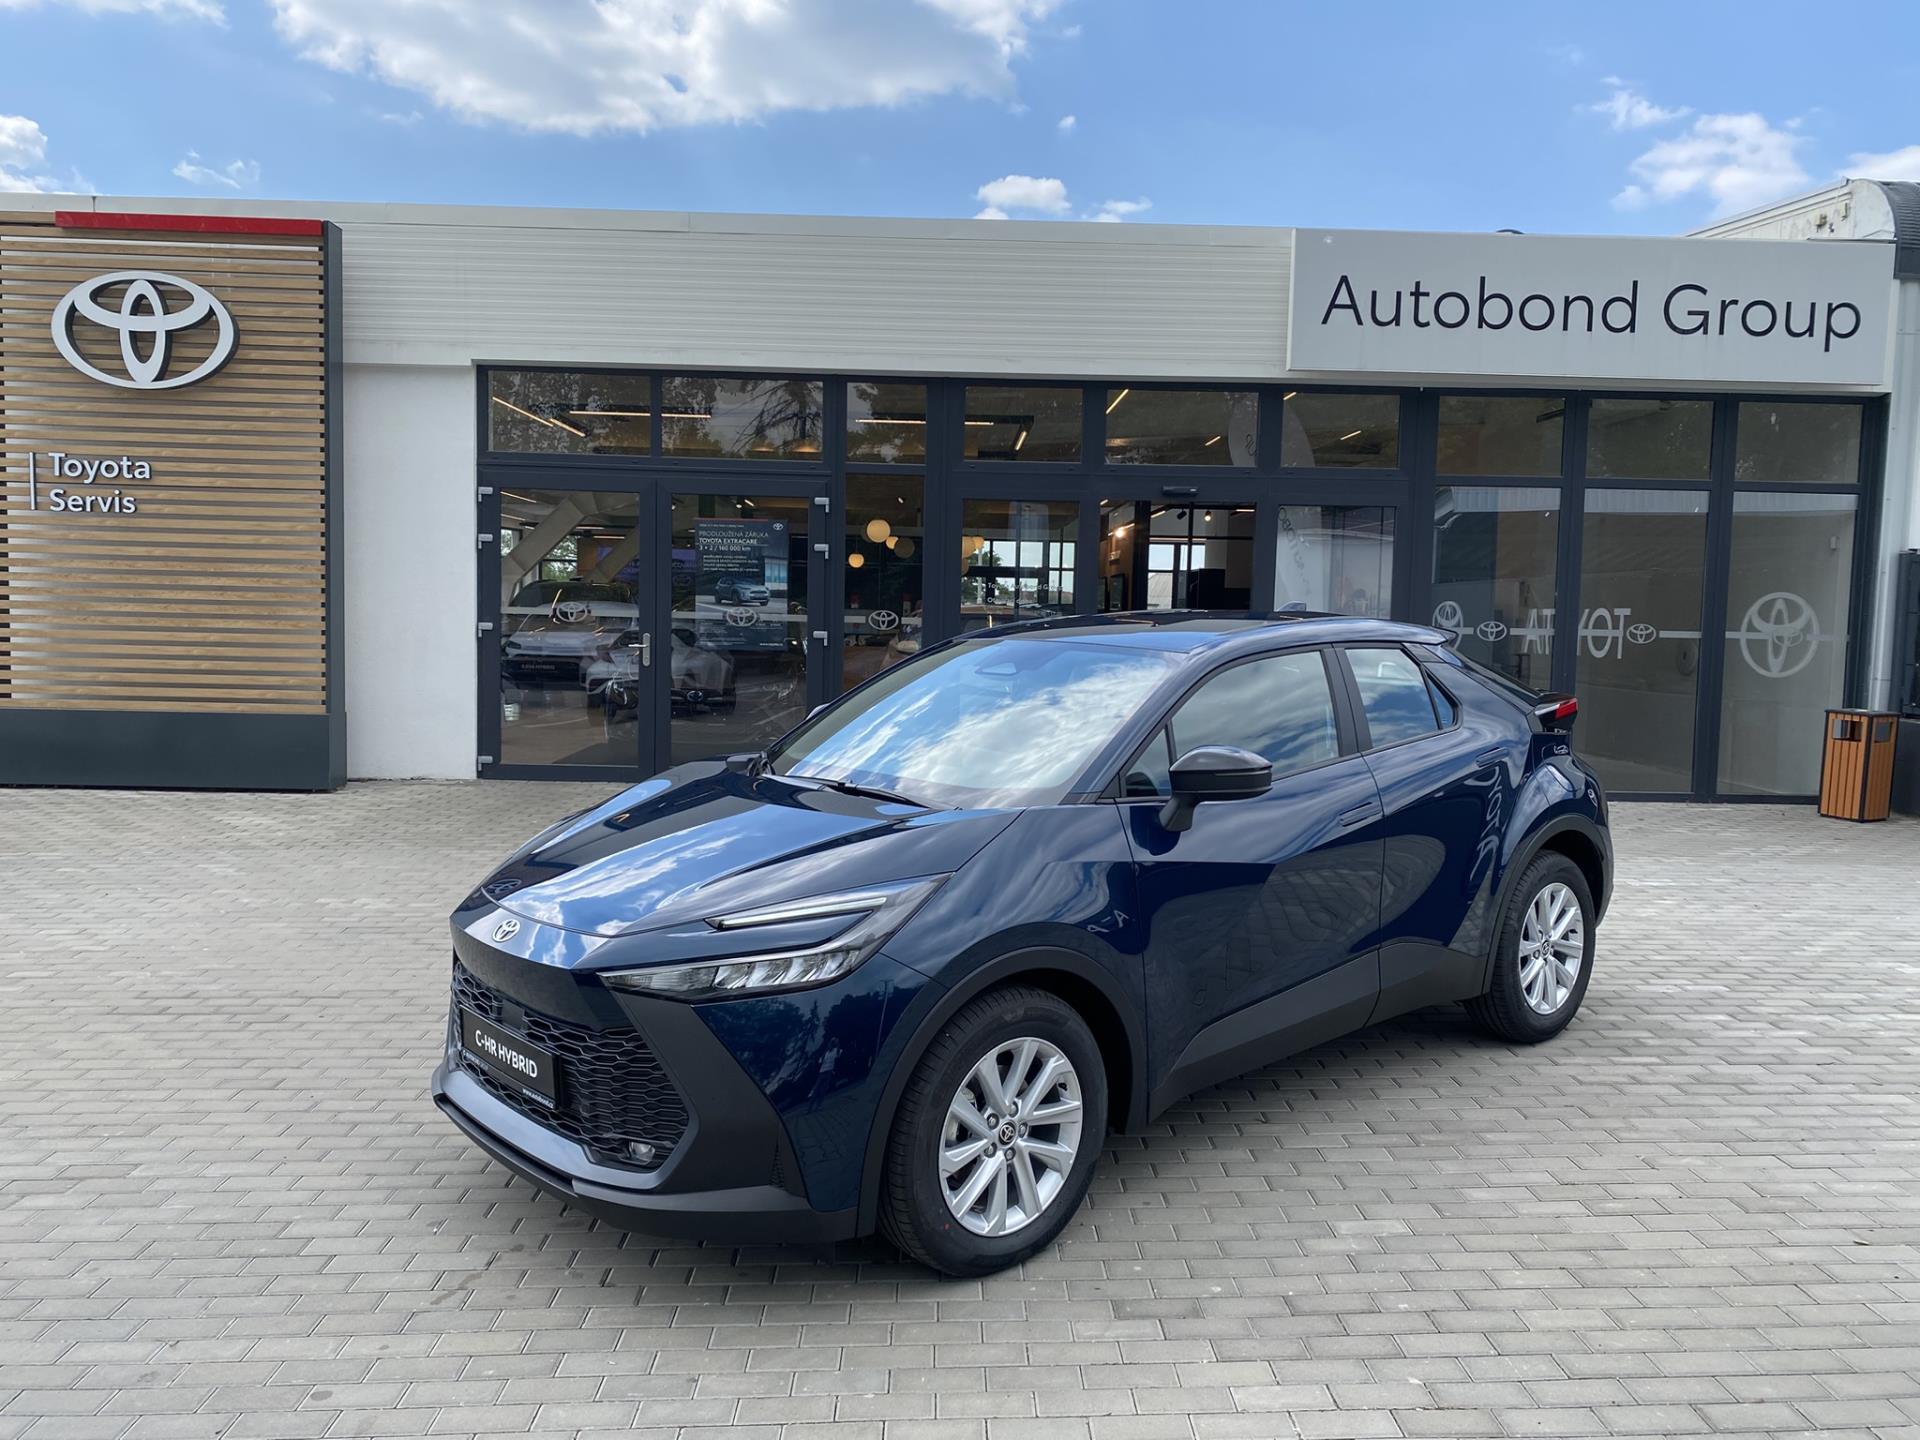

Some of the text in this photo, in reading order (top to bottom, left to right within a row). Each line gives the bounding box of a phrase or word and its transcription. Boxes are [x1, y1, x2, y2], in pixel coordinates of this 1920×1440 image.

[1320, 273, 1862, 352] Autobond Group
[48, 451, 152, 485] Toyota
[49, 489, 137, 515] Servis
[475, 1029, 497, 1057] C-HR
[498, 1042, 538, 1078] HYBRID
